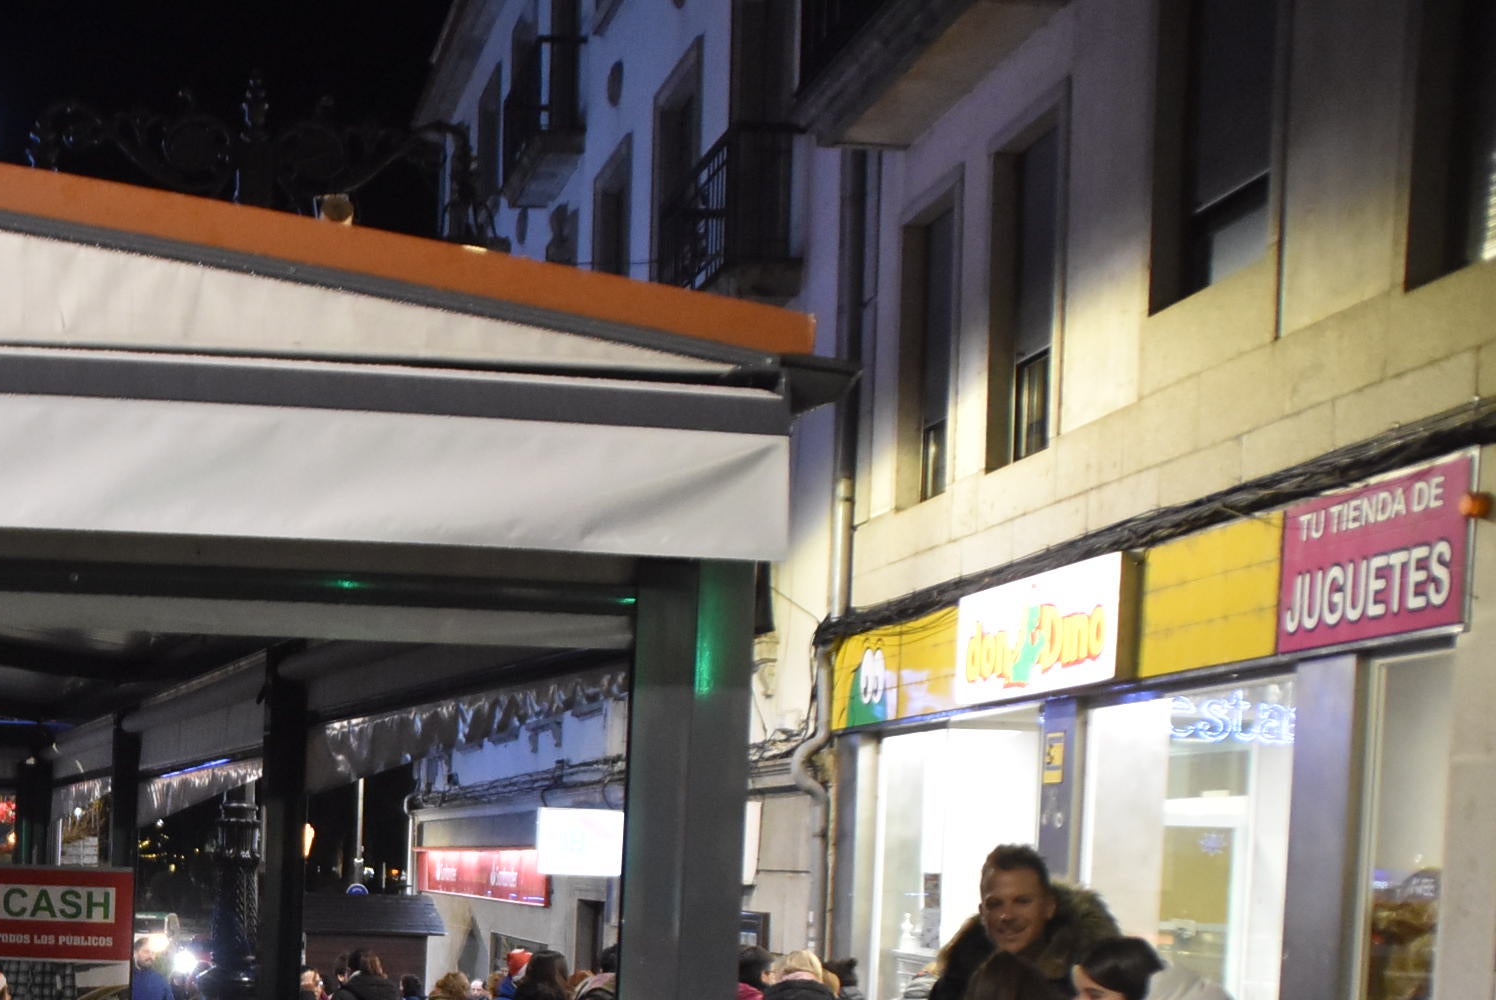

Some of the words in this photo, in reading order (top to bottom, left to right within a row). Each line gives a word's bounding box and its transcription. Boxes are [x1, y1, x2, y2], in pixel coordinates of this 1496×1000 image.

[1298, 509, 1326, 541] TU
[1329, 487, 1407, 534] TIENDA
[1411, 475, 1446, 512] DE
[1285, 538, 1453, 634] JUGUETES
[34, 934, 55, 945] LOS
